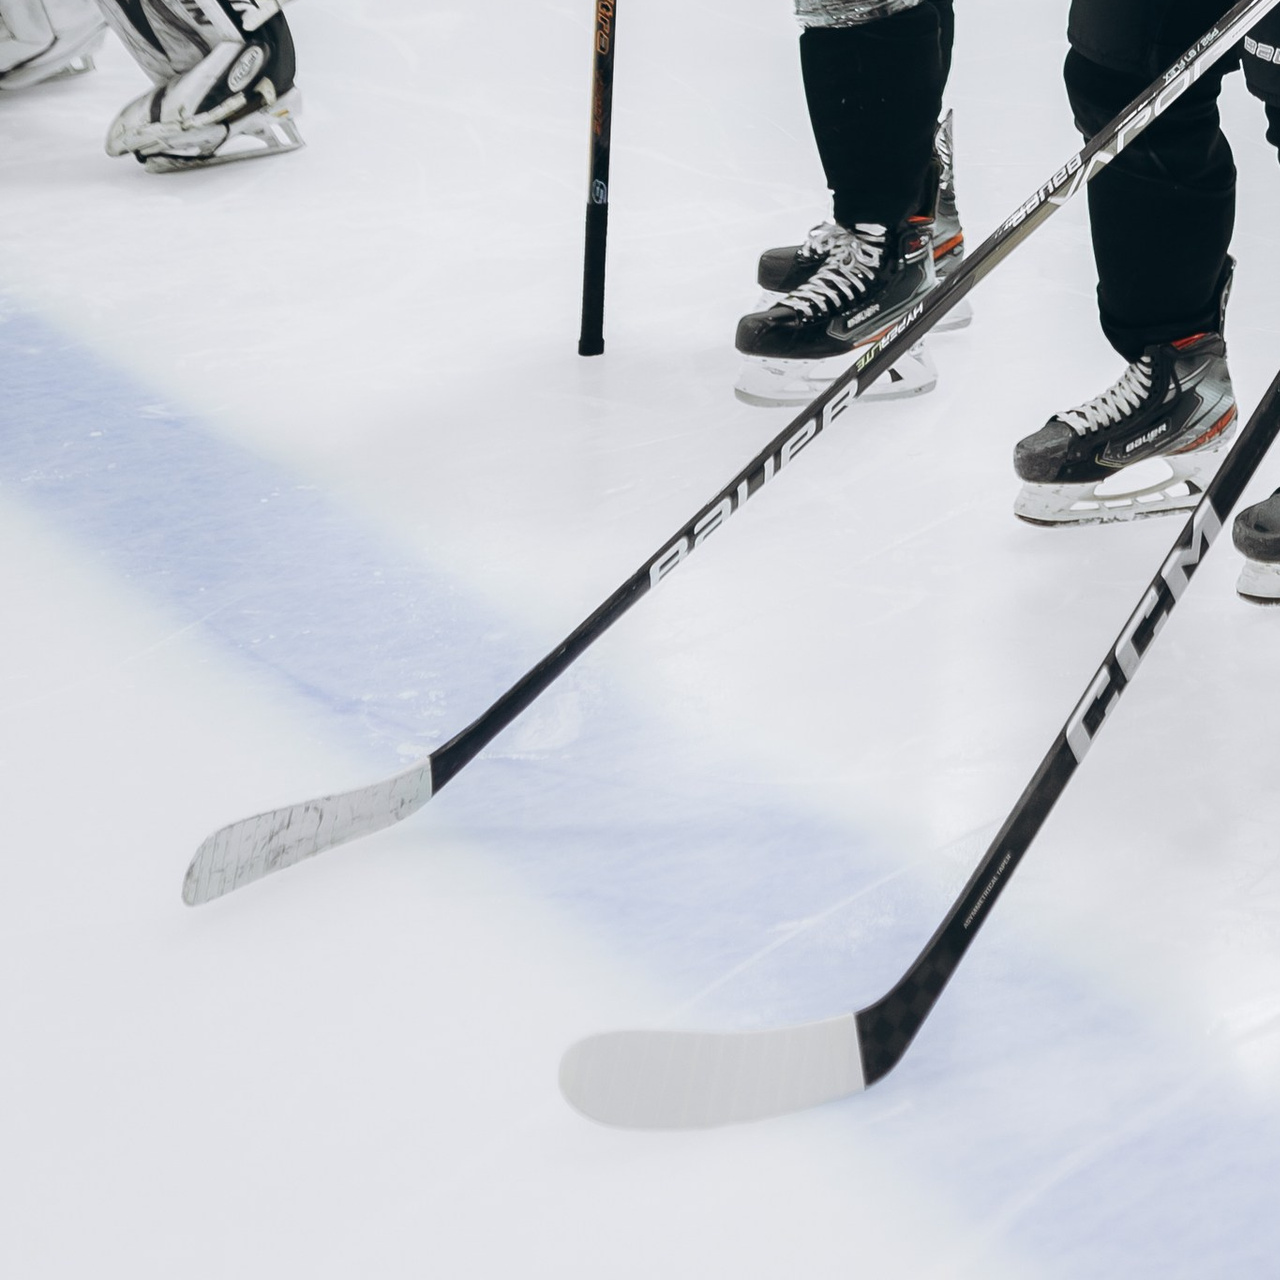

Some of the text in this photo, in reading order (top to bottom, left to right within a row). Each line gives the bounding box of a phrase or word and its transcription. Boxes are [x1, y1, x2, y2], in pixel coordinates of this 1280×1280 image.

[855, 301, 923, 372] HYPERLITE
[1125, 422, 1168, 454] BAUER
[1066, 498, 1224, 765] CCM
